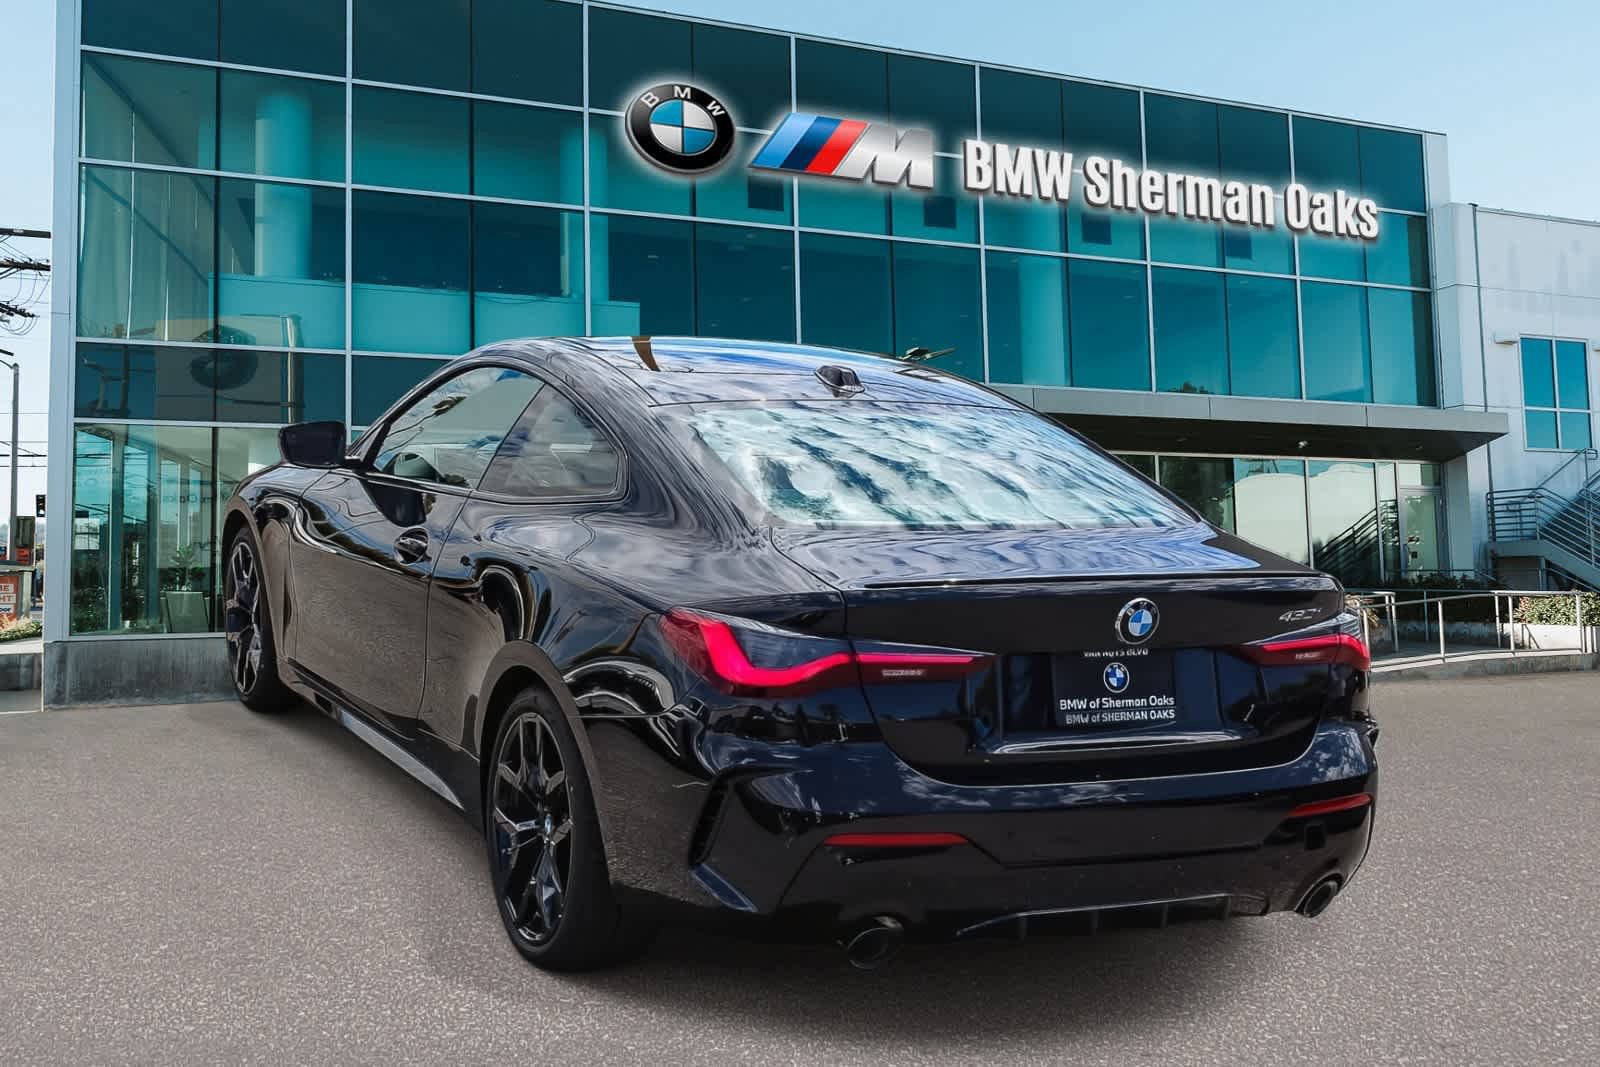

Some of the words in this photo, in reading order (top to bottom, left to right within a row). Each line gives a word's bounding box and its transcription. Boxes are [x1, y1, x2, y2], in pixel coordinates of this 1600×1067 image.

[641, 85, 725, 118] BMW
[963, 138, 1073, 202] BMW
[1083, 155, 1275, 227] Sherman
[1284, 183, 1380, 241] Oaks
[1060, 698, 1087, 710] BMW
[1089, 698, 1101, 708] of
[1102, 697, 1147, 708] Sherman
[1149, 695, 1175, 706] Oaks
[1066, 714, 1089, 724] BMW
[1091, 713, 1100, 723] of
[1102, 711, 1148, 722] SHERMAN
[1149, 709, 1175, 719] OAKS
